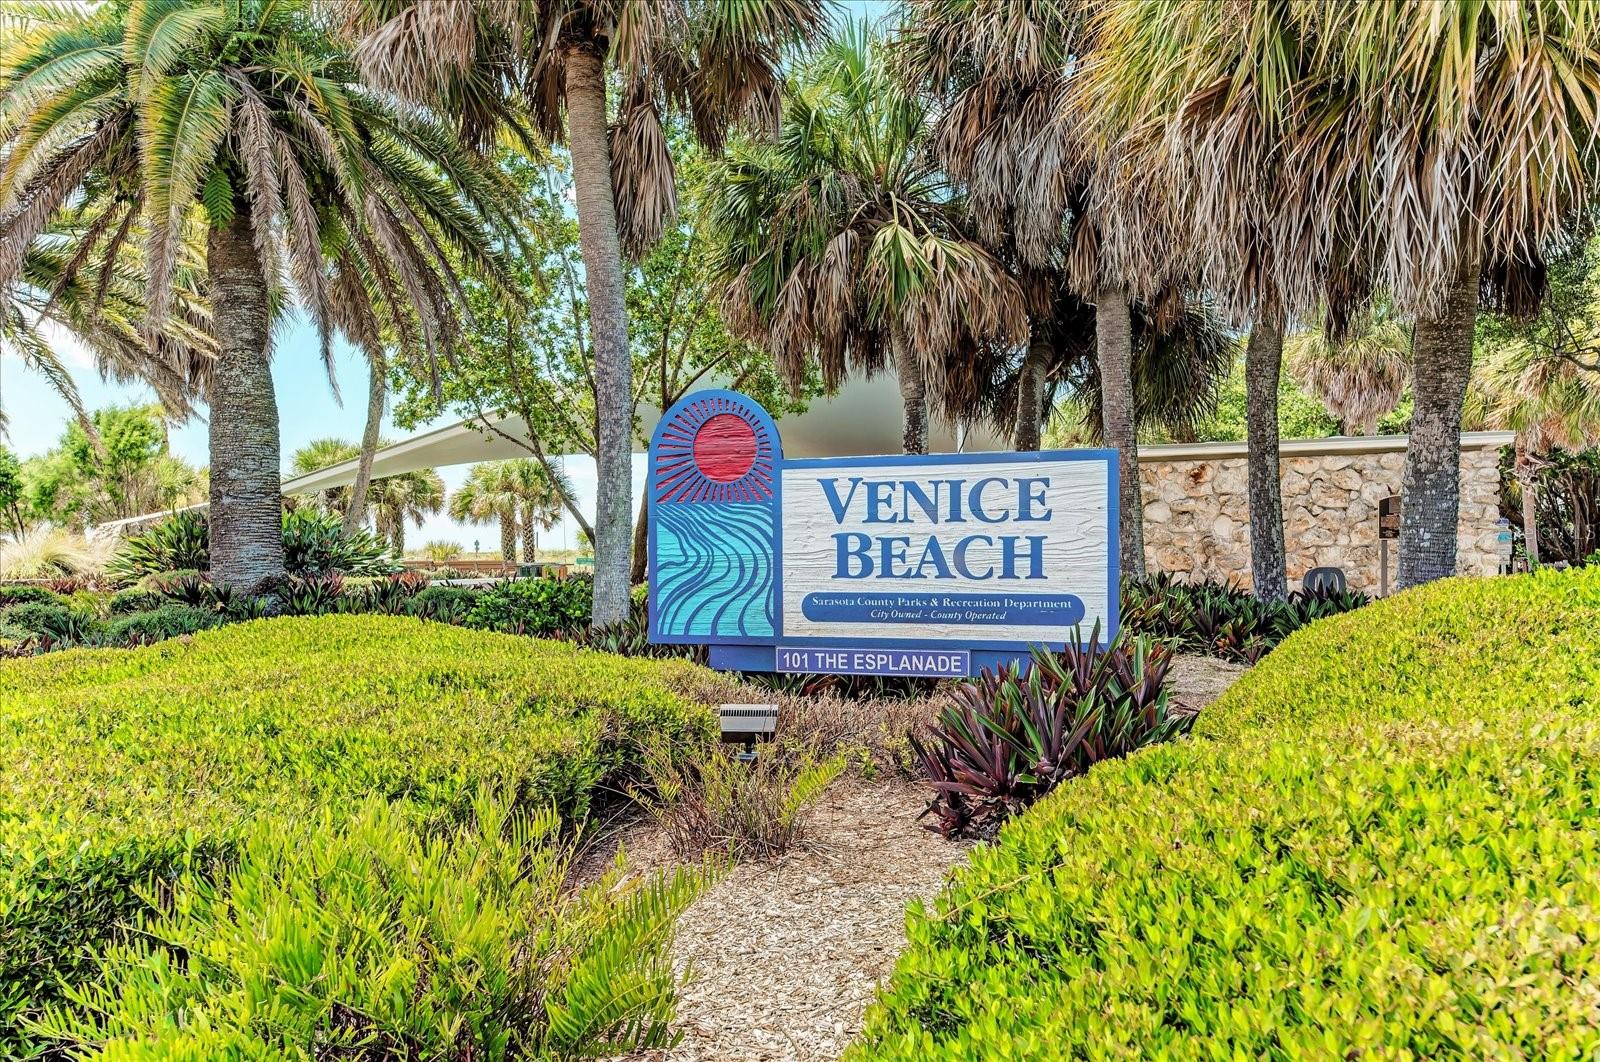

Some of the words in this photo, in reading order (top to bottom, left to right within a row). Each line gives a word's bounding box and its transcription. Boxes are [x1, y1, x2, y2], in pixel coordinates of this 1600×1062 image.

[817, 477, 1053, 525] VENICE
[831, 532, 1048, 580] BEACH
[812, 597, 854, 606] Sarasota
[857, 597, 895, 609] County
[898, 597, 927, 607] Parks
[930, 597, 939, 607] &
[943, 597, 1000, 608] Recreation
[1004, 598, 1072, 610] Department
[870, 609, 890, 620] City
[891, 609, 922, 619] Owned
[930, 610, 963, 621] County
[965, 610, 1007, 621] Operated
[782, 651, 809, 669] 101
[815, 652, 848, 670] THE
[854, 653, 962, 673] ESPLANADE
